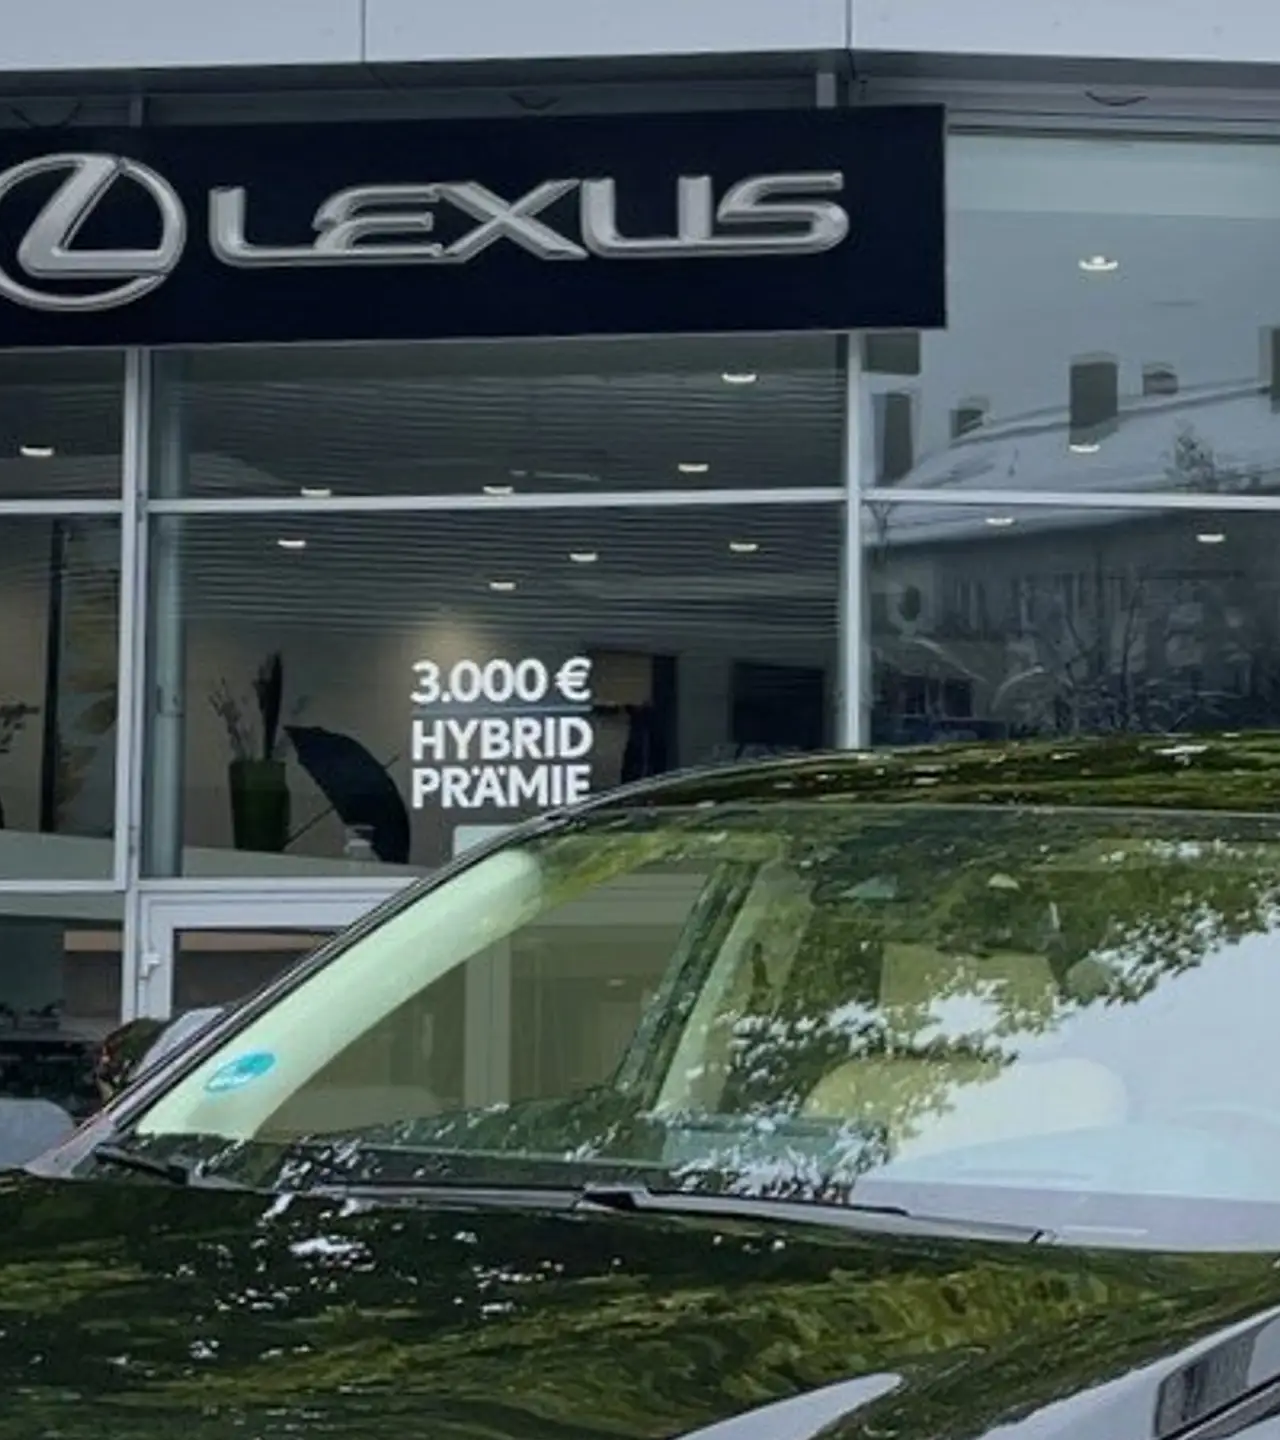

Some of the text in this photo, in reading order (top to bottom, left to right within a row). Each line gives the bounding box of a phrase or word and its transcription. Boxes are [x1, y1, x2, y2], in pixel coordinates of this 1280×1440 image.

[209, 170, 850, 266] LEXUS
[410, 656, 593, 704] 3.000 €
[411, 717, 594, 761] HYBRID
[412, 764, 591, 808] PRÄMIE
